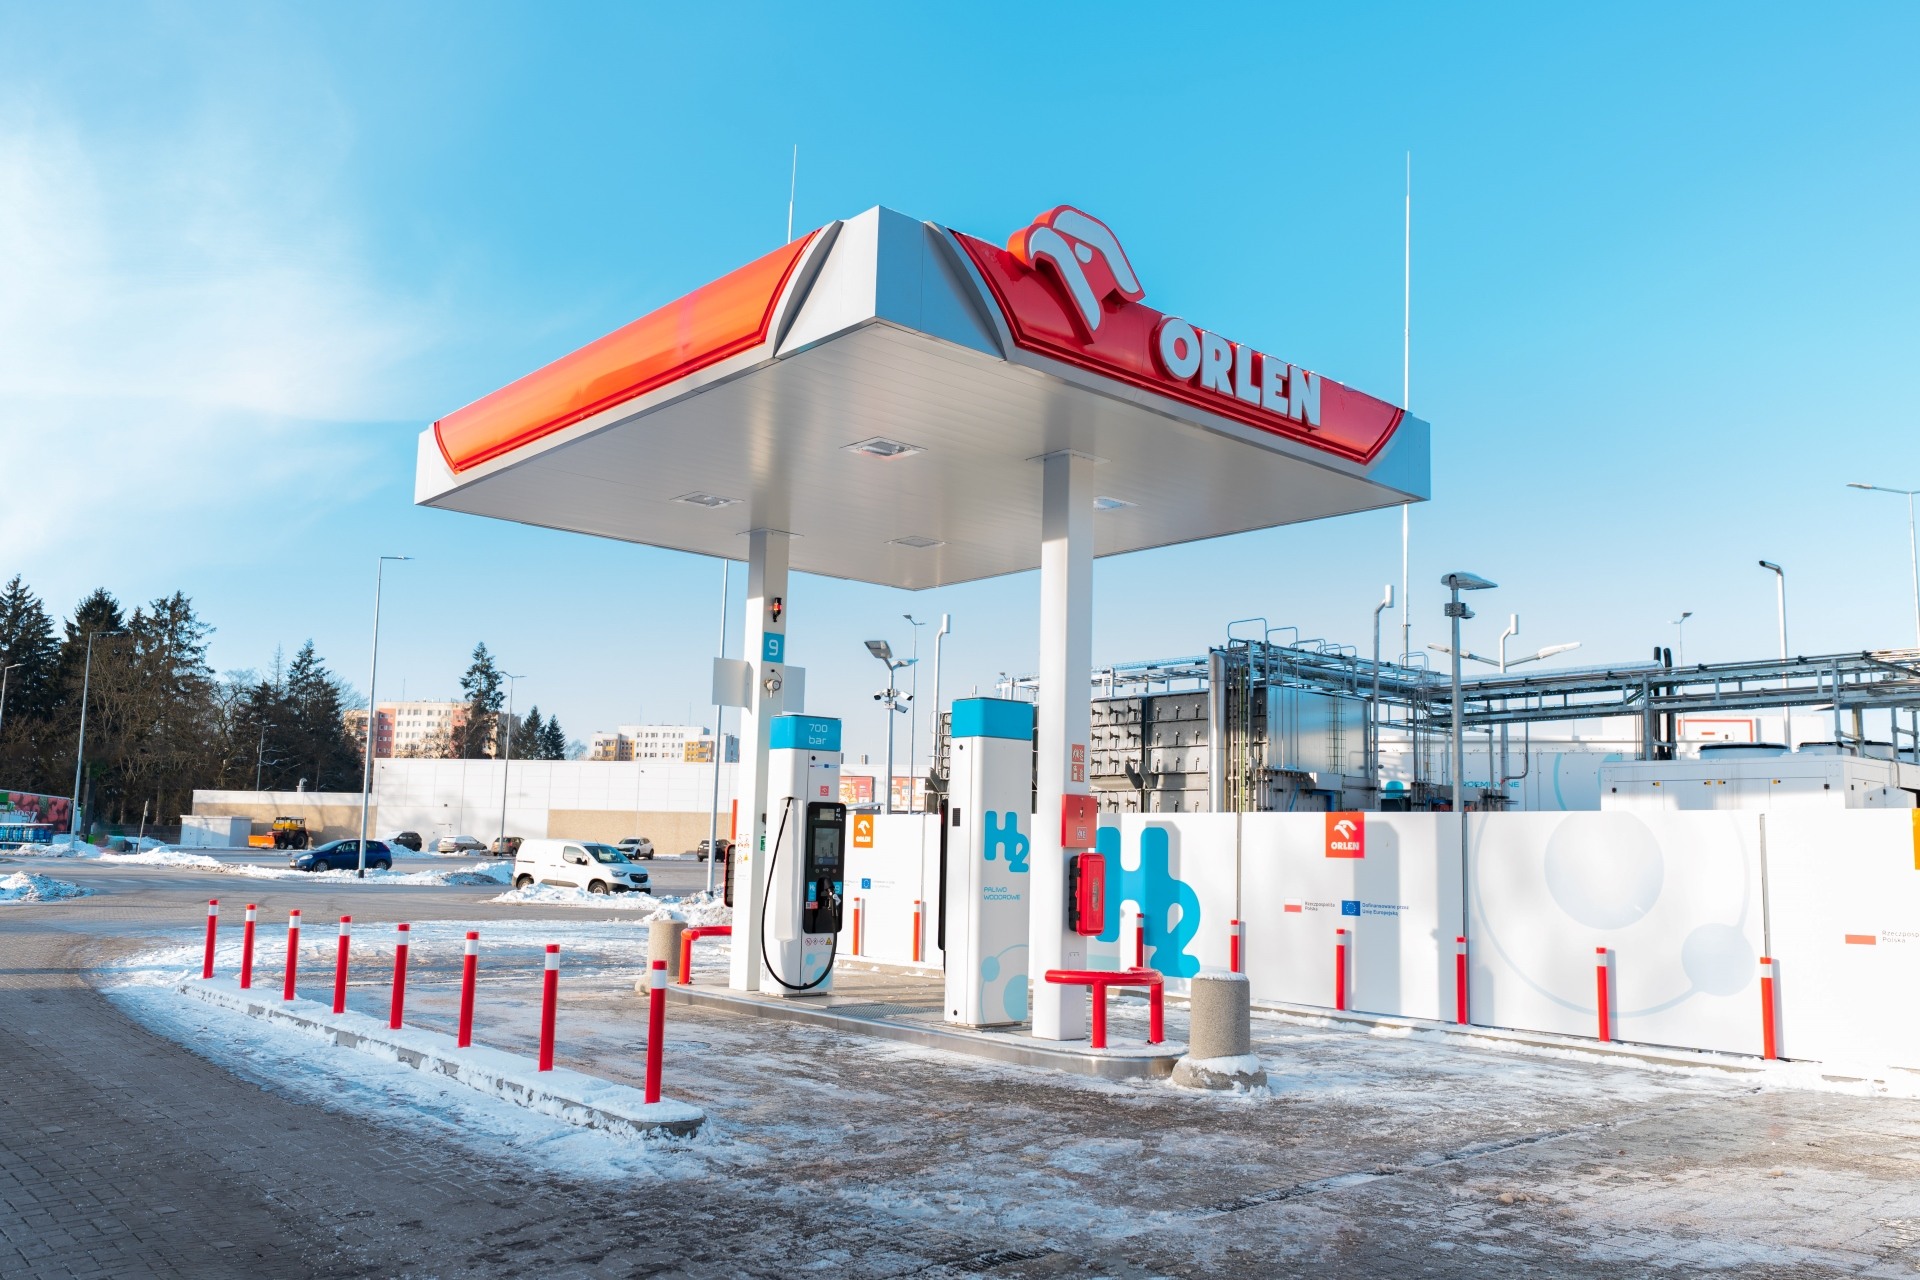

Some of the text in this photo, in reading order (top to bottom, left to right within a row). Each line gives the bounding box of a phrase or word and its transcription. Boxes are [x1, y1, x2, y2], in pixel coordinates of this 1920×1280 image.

[1158, 316, 1321, 428] ORLEN
[768, 639, 779, 657] 9
[808, 723, 828, 733] 700
[808, 735, 827, 745] bar
[1330, 841, 1360, 851] ORLEN
